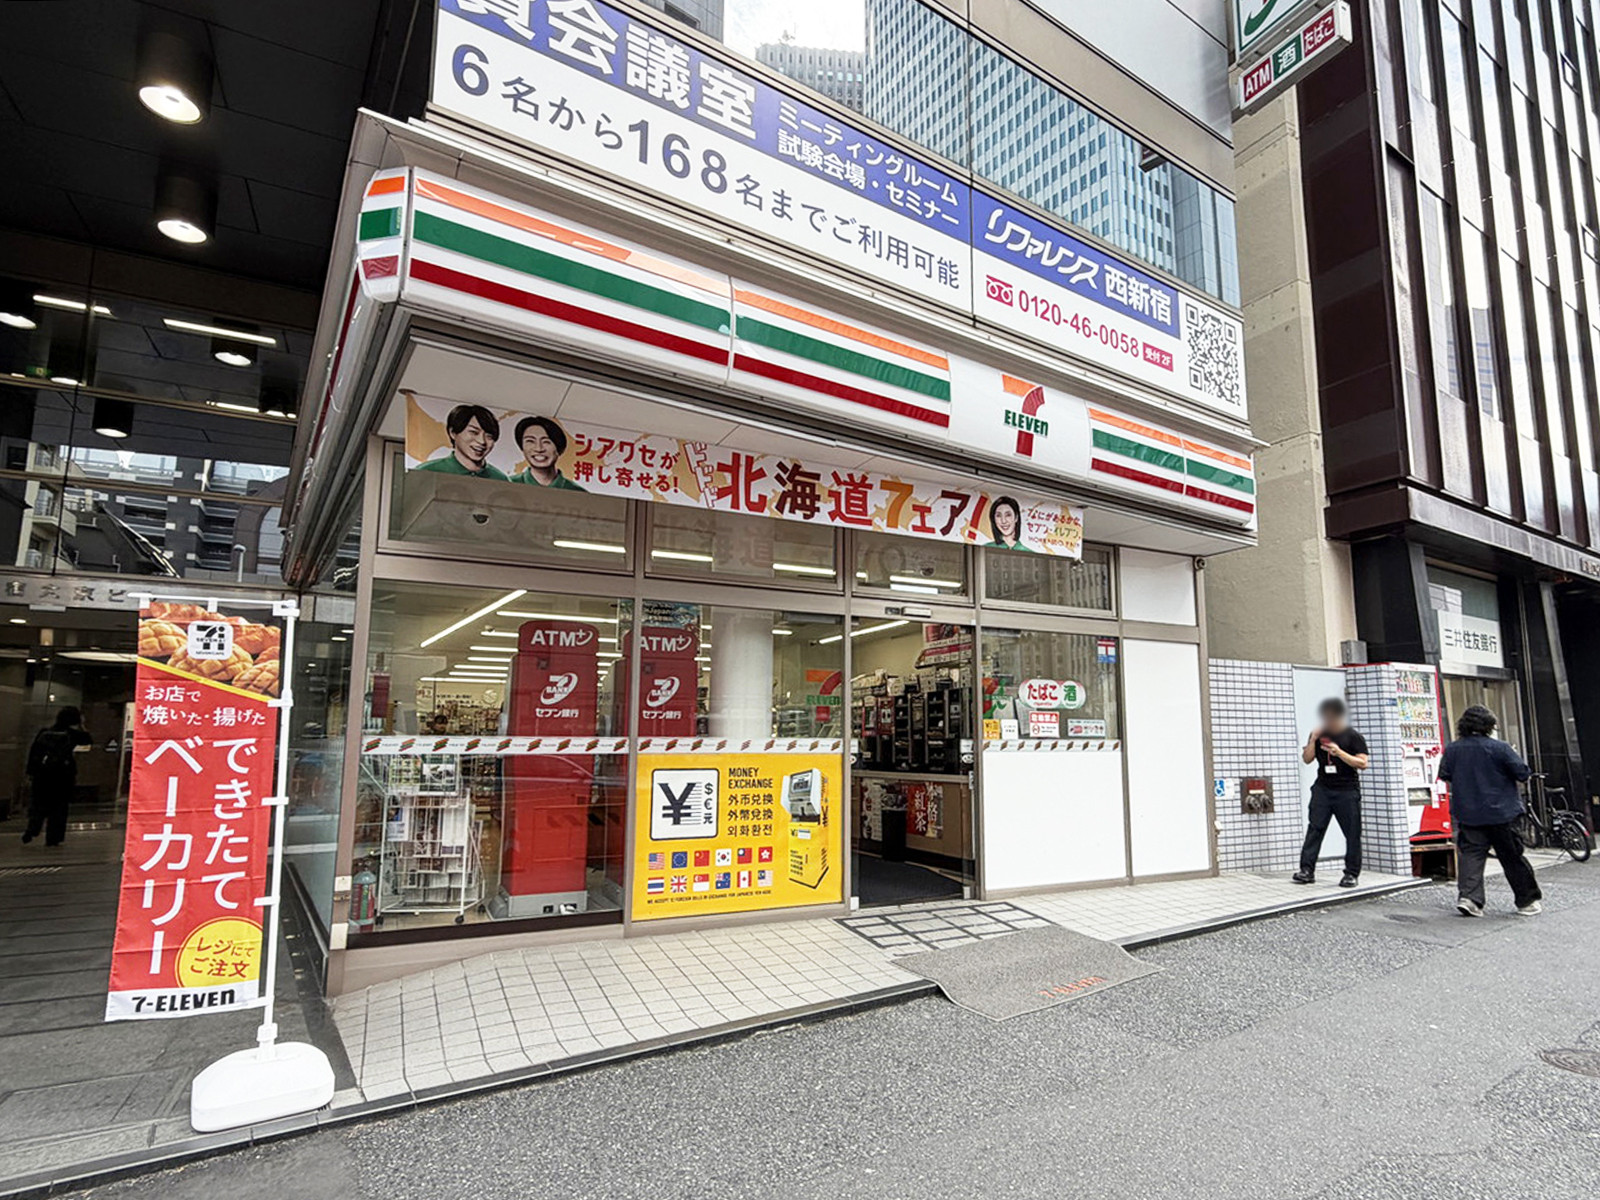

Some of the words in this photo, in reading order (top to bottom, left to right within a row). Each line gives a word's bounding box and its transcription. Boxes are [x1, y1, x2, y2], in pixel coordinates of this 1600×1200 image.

[1305, 16, 1334, 52] たばこ
[1278, 43, 1296, 73] 酒
[1245, 69, 1271, 97] ATM
[779, 101, 958, 206] ミーティングルーム
[778, 129, 959, 224] 試験会場・セミナー
[985, 209, 1098, 290] リファレンス
[1105, 264, 1171, 325] 西新宿
[1019, 290, 1140, 357] 0120-46-0058
[575, 433, 681, 470] シアワセが
[1444, 628, 1497, 653] 三井住友銀行
[145, 685, 201, 703] お店で
[1027, 682, 1058, 701] たばこ
[1063, 685, 1077, 702] 酒
[142, 705, 266, 727] 焼いた・揚げた
[535, 707, 579, 718] セブン銀行
[642, 710, 682, 719] セブン銀行
[728, 767, 760, 778] MONEY
[728, 778, 774, 789] EXCHANGE
[202, 738, 258, 910] できたて
[727, 824, 773, 837] 외화환전
[140, 735, 204, 975] ベーカリー
[197, 936, 255, 957] レジにて
[191, 957, 250, 978] ご注文
